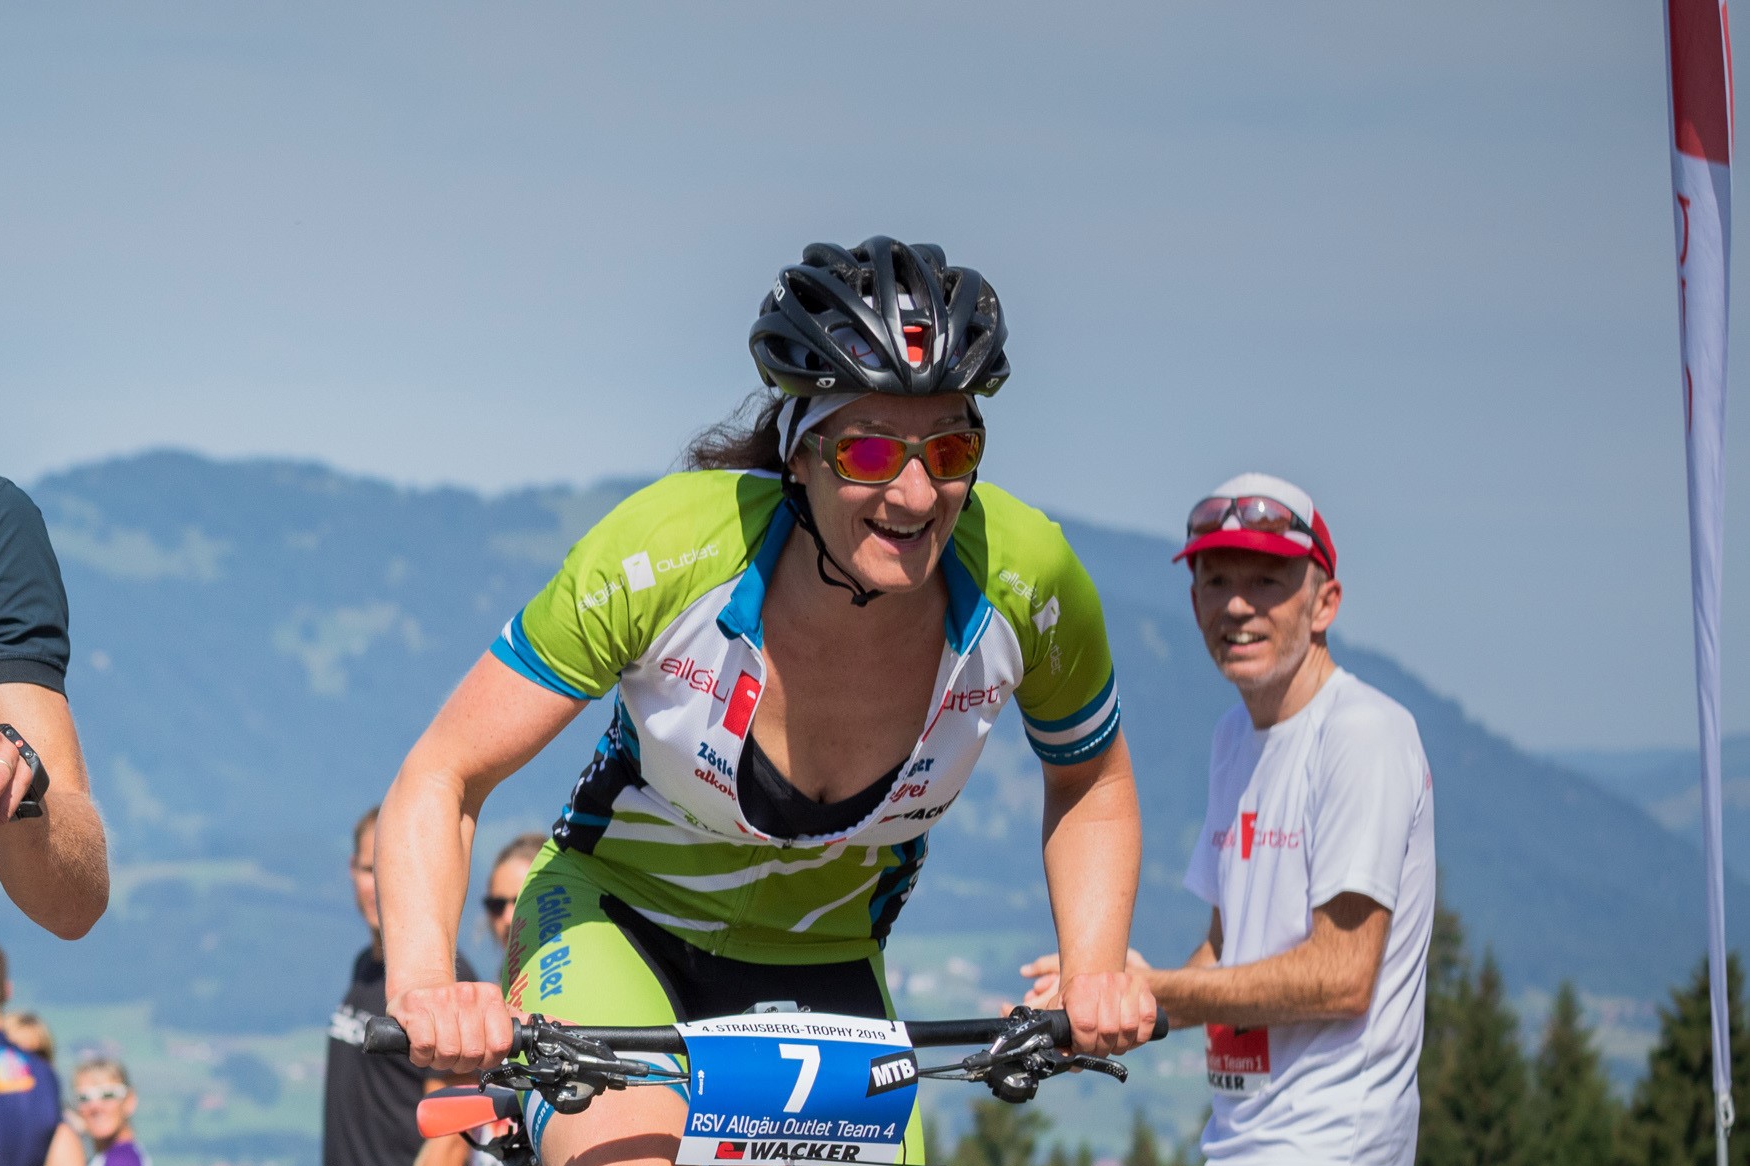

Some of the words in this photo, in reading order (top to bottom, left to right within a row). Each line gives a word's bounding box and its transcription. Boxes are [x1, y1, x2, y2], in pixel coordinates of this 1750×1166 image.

[656, 543, 719, 573] outlet
[998, 569, 1043, 609] allgäu
[660, 656, 730, 704] allgäu
[943, 684, 1000, 713] utlet
[697, 741, 735, 782] Zötle
[537, 886, 572, 946] Zötler
[540, 945, 571, 1001] Bier
[718, 1022, 853, 1039] STRAUSBERG-TROPHY
[856, 1028, 887, 1041] 2019
[779, 1043, 821, 1113] 7
[871, 1059, 916, 1088] MTB
[691, 1112, 726, 1133] RSV
[725, 1115, 778, 1139] Allgäu
[782, 1118, 833, 1137] Outlet
[837, 1120, 881, 1139] Team
[883, 1122, 896, 1140] 4
[750, 1141, 861, 1163] WACKER
